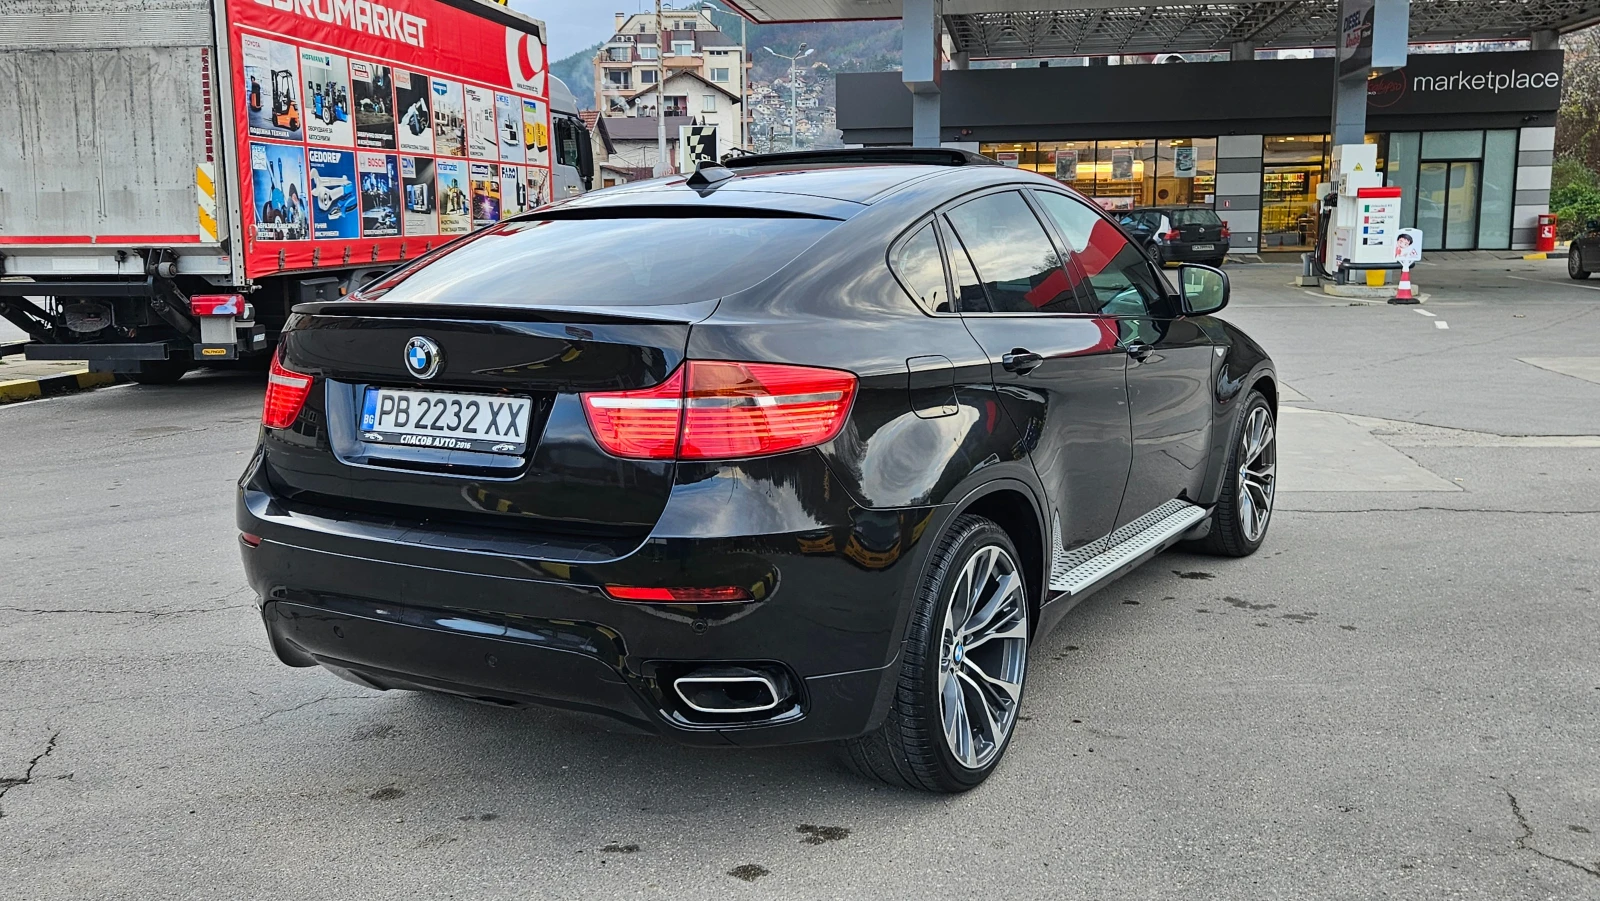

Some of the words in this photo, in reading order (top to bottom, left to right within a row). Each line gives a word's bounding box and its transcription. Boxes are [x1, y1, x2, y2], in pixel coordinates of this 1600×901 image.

[253, 0, 427, 48] ROMARKET
[244, 39, 261, 48] TOYOTA
[302, 53, 324, 64] HOFMANN
[1413, 69, 1559, 94] marketplace
[309, 151, 337, 163] GEDORE
[367, 157, 386, 168] BOSCH
[363, 414, 375, 425] BG
[378, 394, 410, 428] PB
[414, 397, 481, 434] 2232
[484, 401, 525, 438] XX
[400, 434, 433, 446] СПАСОВ
[433, 437, 456, 449] АУТО
[456, 441, 472, 450] 2016
